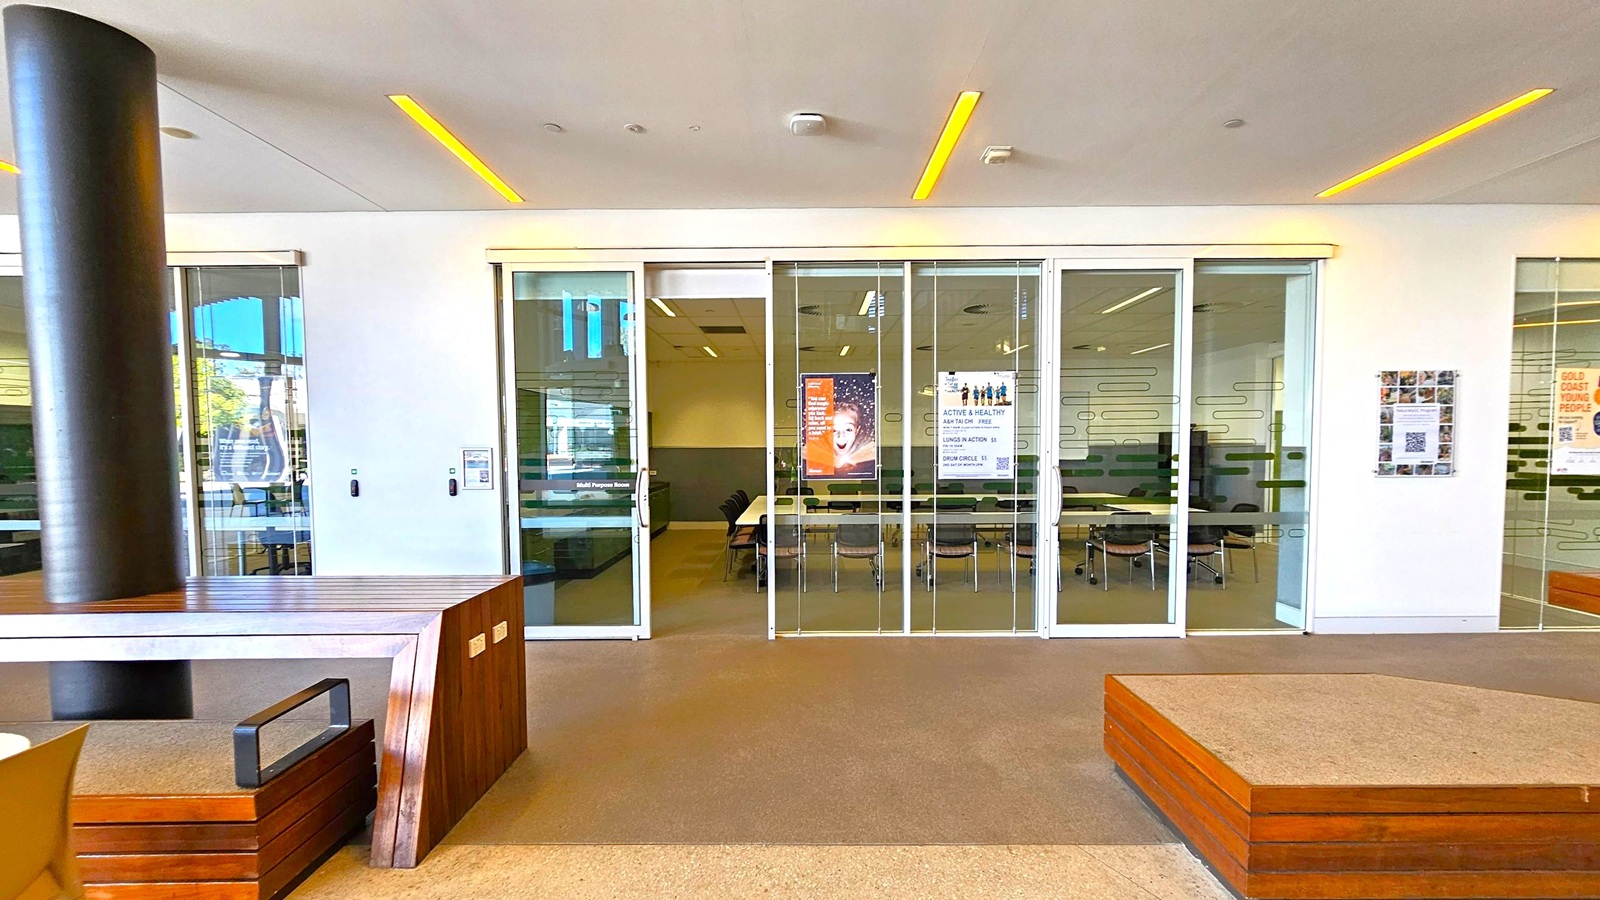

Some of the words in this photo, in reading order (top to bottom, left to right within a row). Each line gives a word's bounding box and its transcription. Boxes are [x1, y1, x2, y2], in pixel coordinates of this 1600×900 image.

[1562, 372, 1585, 380] GOLD
[1560, 382, 1588, 391] COAST
[1560, 393, 1589, 402] YOUNG
[1559, 404, 1592, 412] PEOPLE
